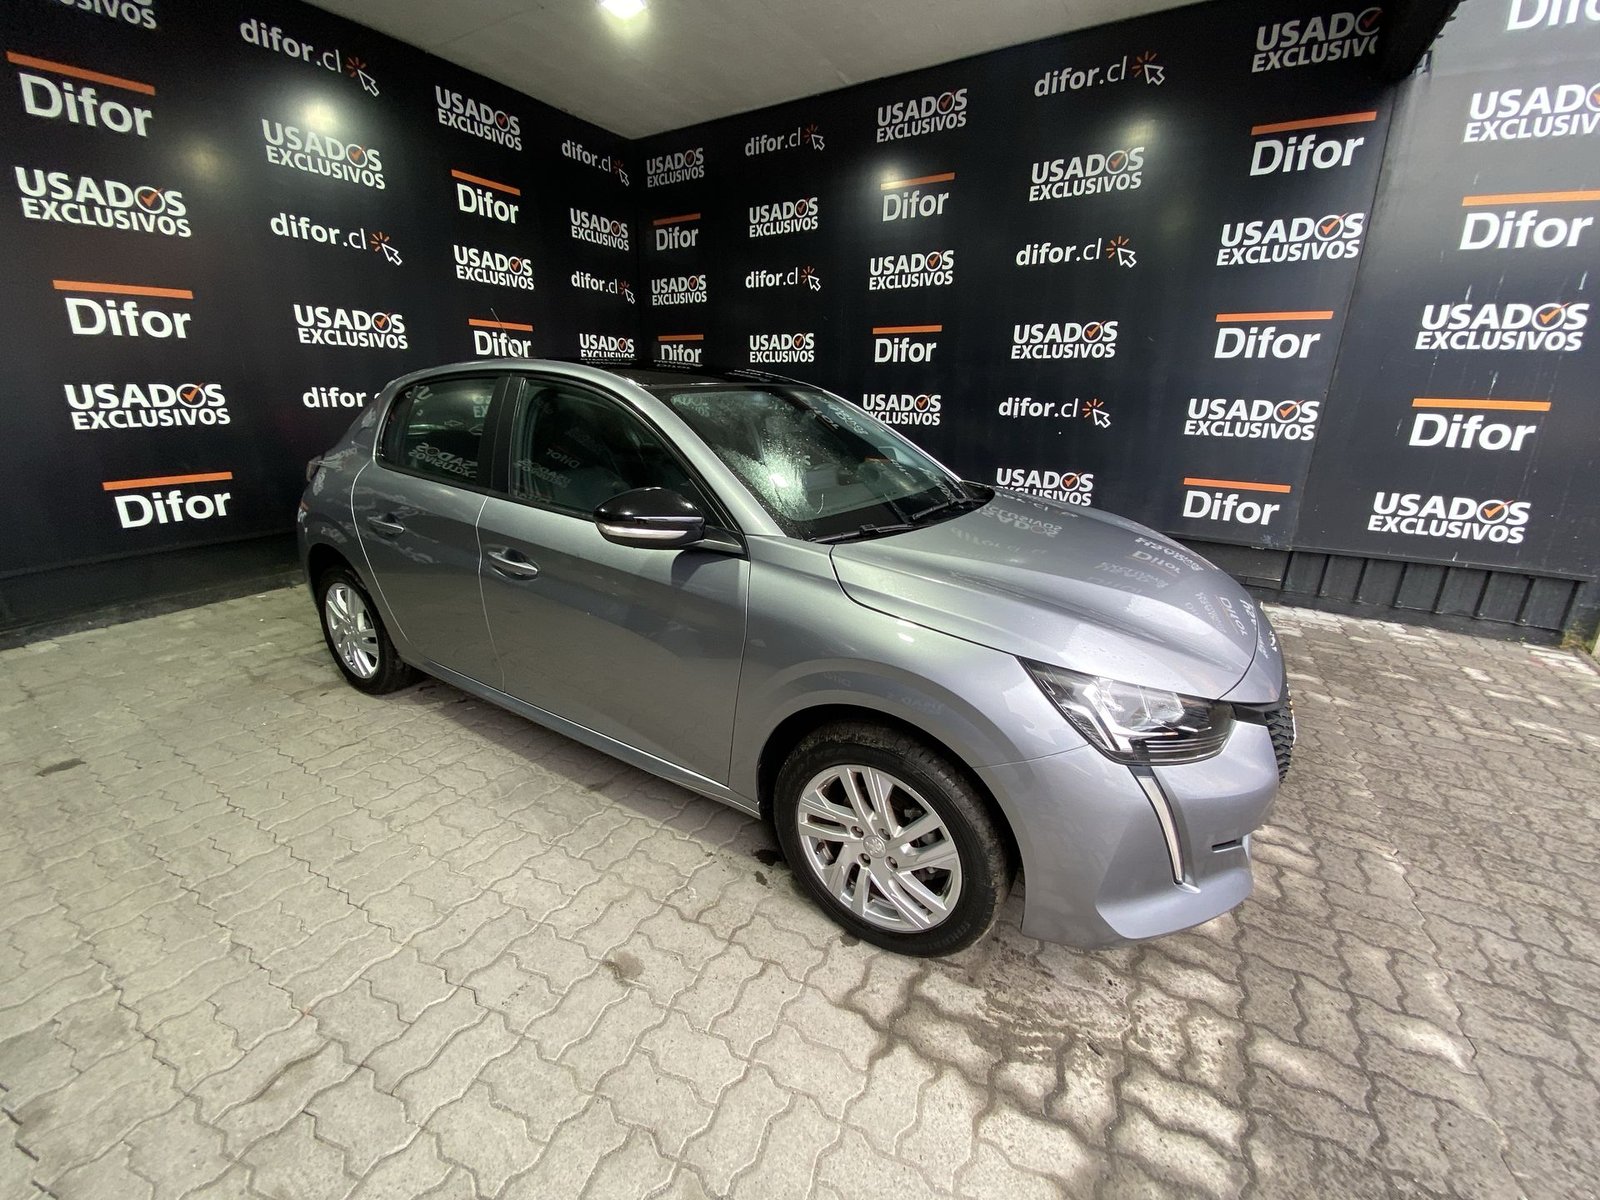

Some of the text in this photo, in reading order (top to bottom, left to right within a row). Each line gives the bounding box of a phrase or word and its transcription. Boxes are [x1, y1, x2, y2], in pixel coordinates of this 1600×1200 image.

[1256, 7, 1382, 52] USADO
[240, 19, 342, 73] difor.cl
[1252, 36, 1378, 73] EXCLUSIV
[1034, 56, 1127, 97] difor.cl
[19, 72, 153, 137] Difor
[435, 85, 521, 136] USADOS
[877, 88, 968, 127] USADOS
[438, 108, 522, 151] EXCLUSIVOS
[876, 110, 967, 143] EXCLUSIVOS
[262, 118, 382, 171] USADOS
[744, 127, 801, 156] difor.cl
[1249, 134, 1364, 177] Difor
[266, 145, 386, 190] EXCLUSIVOS
[562, 140, 611, 173] difor.cl
[646, 148, 704, 175] USADOS
[1031, 147, 1144, 185] USADOS
[647, 165, 705, 188] EXCLUSIVOS
[1028, 172, 1142, 202] EXCLUSIVOS
[15, 166, 187, 217] USADOS
[457, 183, 519, 225] Difor
[21, 197, 192, 238] EXCLUSIVOS
[749, 197, 818, 224] USADOS
[882, 192, 949, 221] Difor
[270, 213, 367, 250] difor.cl
[570, 208, 628, 239] USADOS
[749, 216, 818, 238] EXCLUSIVOS
[1220, 212, 1364, 248] USADOS
[1459, 210, 1594, 250] Difor
[571, 225, 629, 251] EXCLUSIVOS
[655, 227, 699, 251] Difor
[1015, 238, 1102, 266] difor.cl
[453, 244, 532, 276] USADOS
[869, 250, 954, 276] USADOS
[1216, 239, 1360, 266] EXCLUSIVOS
[456, 264, 534, 291] EXCLUSIVOS
[571, 271, 618, 295] difor.cl
[651, 274, 706, 295] USADOS
[745, 267, 798, 289] difor.cl
[869, 267, 954, 291] EXCLUSIVOS
[652, 291, 707, 306] EXCLUSIVOS
[65, 297, 191, 339] Difor
[293, 304, 405, 334] USADOS
[1421, 303, 1590, 331] USADOS
[298, 327, 408, 350] EXCLUSIVOS
[473, 330, 532, 358] Difor
[579, 333, 635, 353] USADOS
[749, 332, 815, 351] USADOS
[1013, 320, 1118, 345] USADOS
[1214, 326, 1320, 359] Difor
[1415, 331, 1584, 351] EXCLUSIVOS
[660, 343, 702, 363] Difor
[749, 349, 815, 363] EXCLUSIVOS
[874, 338, 937, 363] Difor
[1011, 342, 1116, 360] EXCLUSIVOS
[64, 383, 226, 409] USADOS
[303, 387, 380, 408] difor
[863, 393, 942, 413] USADOS
[999, 397, 1078, 418] difor.cl
[71, 407, 231, 430] EXCLUSIVOS
[866, 411, 941, 426] XCLUSIVOS
[1187, 398, 1320, 423] USADOS
[1184, 420, 1315, 441] EXCLUSIVOS
[1409, 413, 1537, 451] Difor
[996, 468, 1094, 492] USADOS
[115, 491, 231, 529] Difor
[1183, 490, 1280, 526] Difor
[1373, 492, 1531, 525] USADOS
[1367, 515, 1525, 544] EXCLUSIVOS
